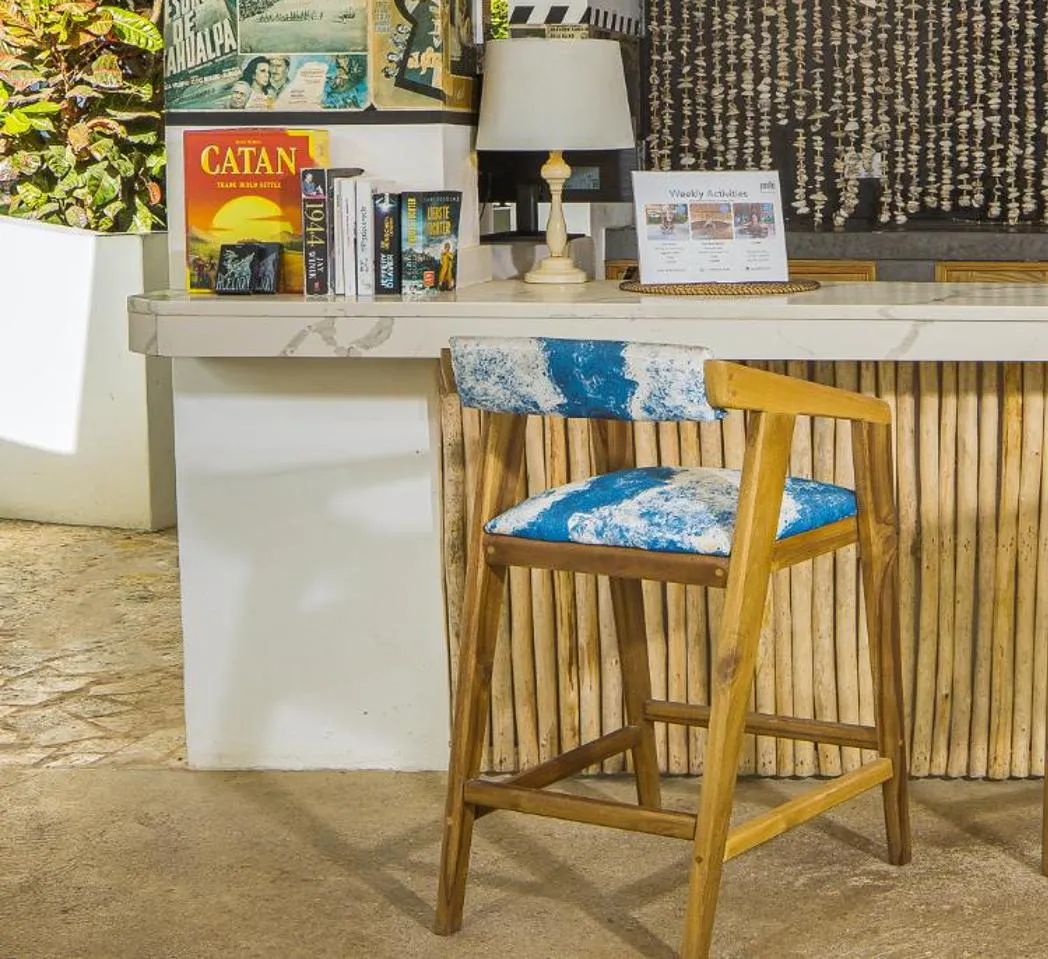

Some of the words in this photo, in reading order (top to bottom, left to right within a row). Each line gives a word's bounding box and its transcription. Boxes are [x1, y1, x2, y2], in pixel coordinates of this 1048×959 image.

[163, 17, 237, 78] AHUALPA
[200, 144, 297, 176] CATAN
[668, 188, 704, 199] Weekly
[707, 188, 749, 198] Activities
[304, 202, 325, 247] 1944
